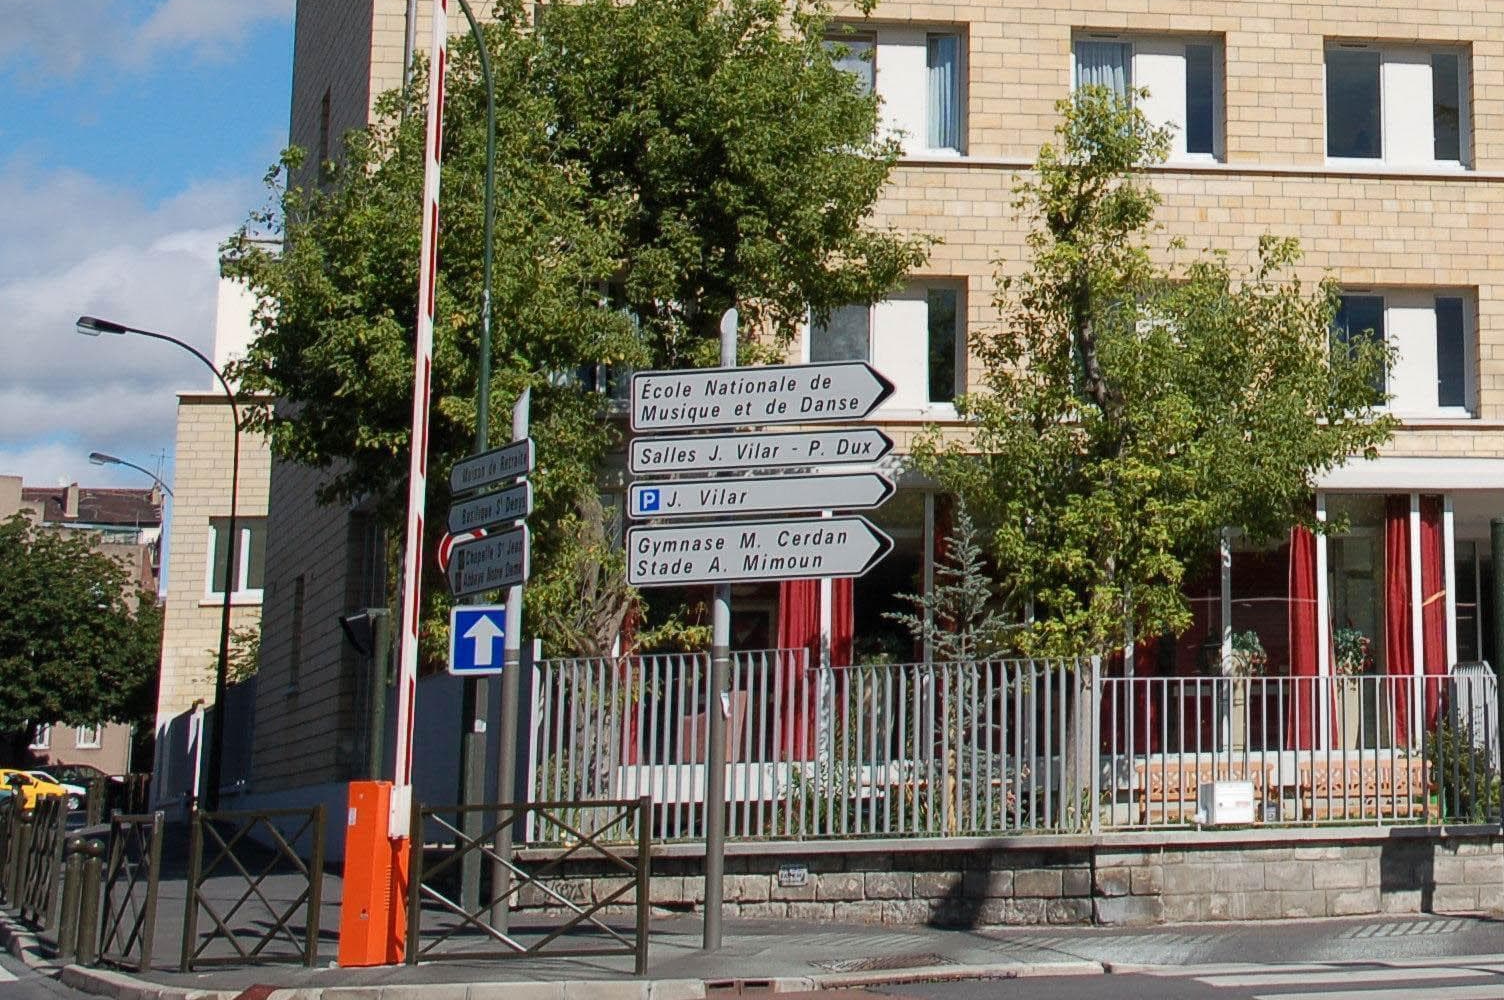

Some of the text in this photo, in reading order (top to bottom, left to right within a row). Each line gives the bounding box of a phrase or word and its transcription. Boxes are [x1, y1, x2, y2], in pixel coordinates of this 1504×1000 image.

[641, 374, 832, 400] École Nationale de
[641, 395, 859, 423] Musique et de Danse
[640, 447, 697, 465] Salles
[708, 445, 723, 462] J.
[737, 443, 780, 460] Vilar
[808, 439, 825, 456] P.
[836, 438, 873, 455] Dux
[462, 450, 527, 483] Maison de Retraite
[667, 491, 682, 508] J.
[700, 488, 748, 506] Vilar
[462, 505, 493, 524] Basilique
[466, 545, 494, 566] Chapelle
[637, 528, 848, 557] Gymnase M. Cerdan
[636, 554, 823, 577] Stade A. Mimoun
